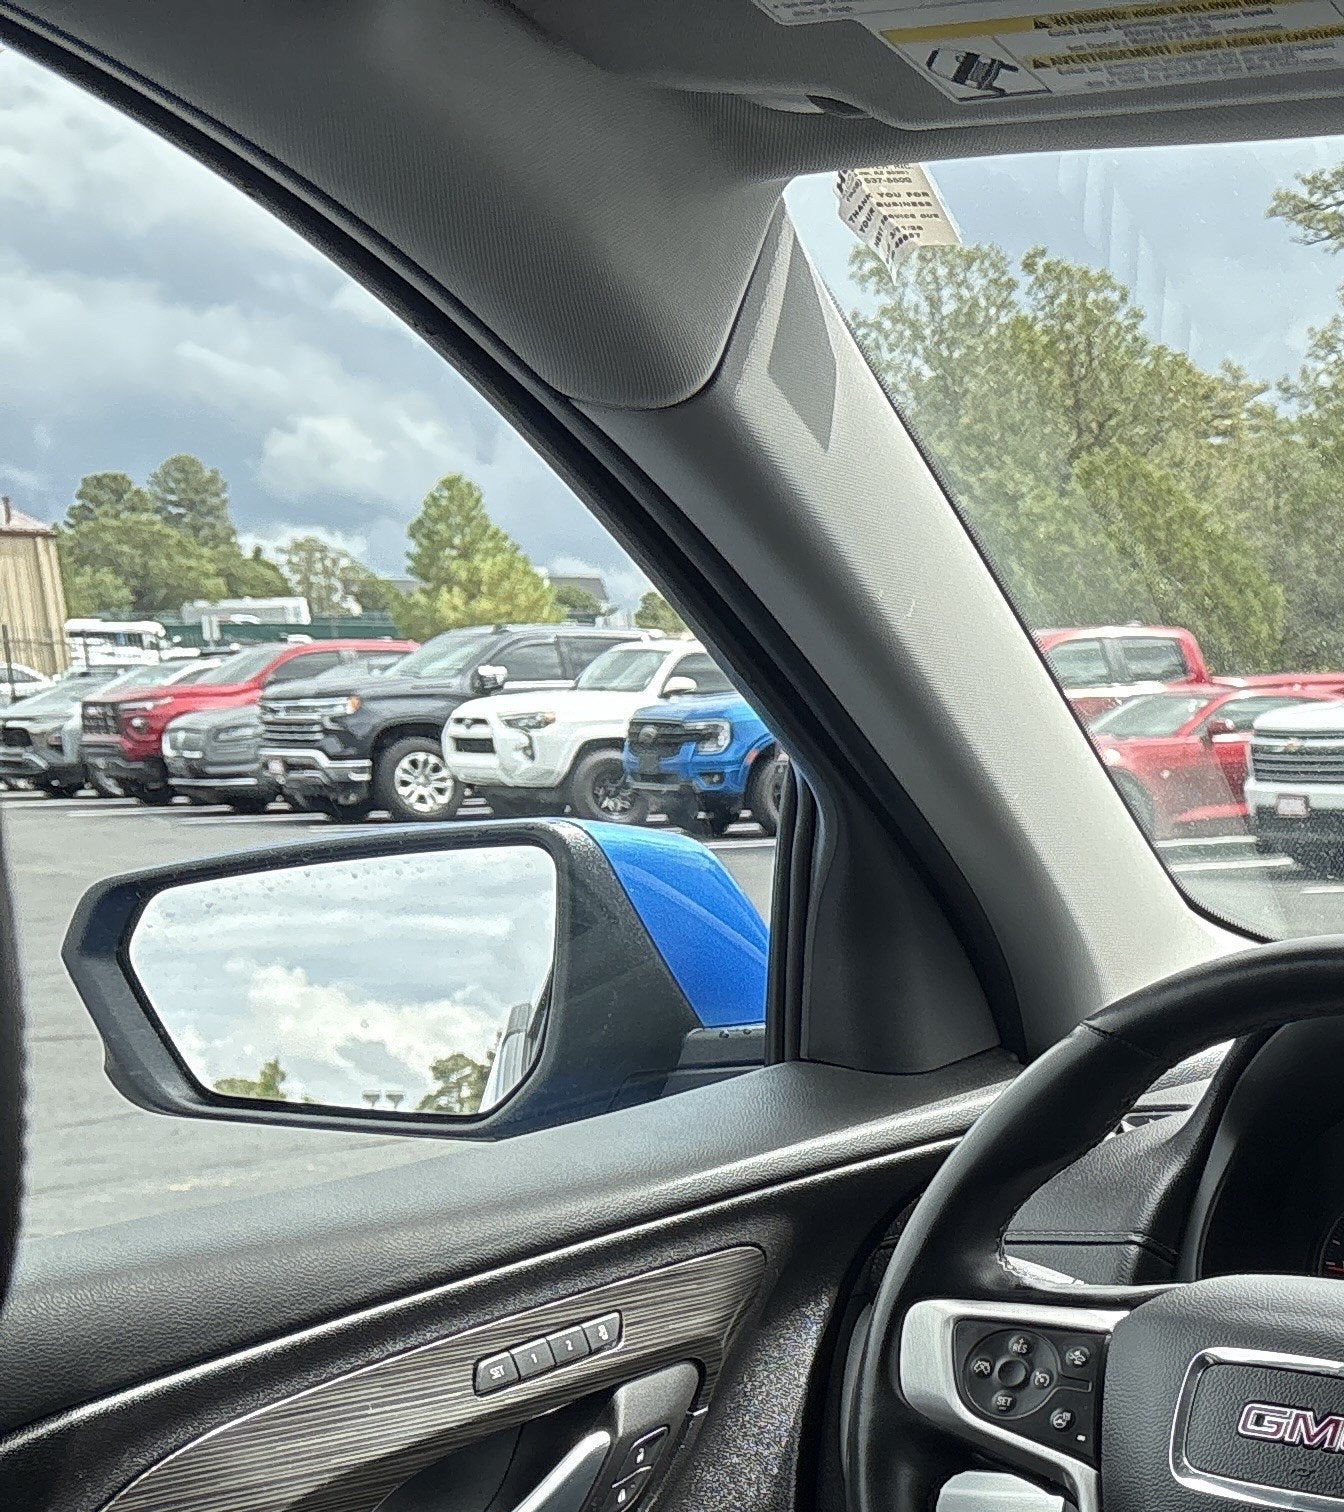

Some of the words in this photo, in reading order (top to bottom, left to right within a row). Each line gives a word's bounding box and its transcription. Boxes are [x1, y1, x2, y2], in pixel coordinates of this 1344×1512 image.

[565, 1340, 573, 1351] 2
[530, 1353, 538, 1363] 1
[489, 1365, 506, 1380] SET
[996, 1396, 1013, 1407] SET
